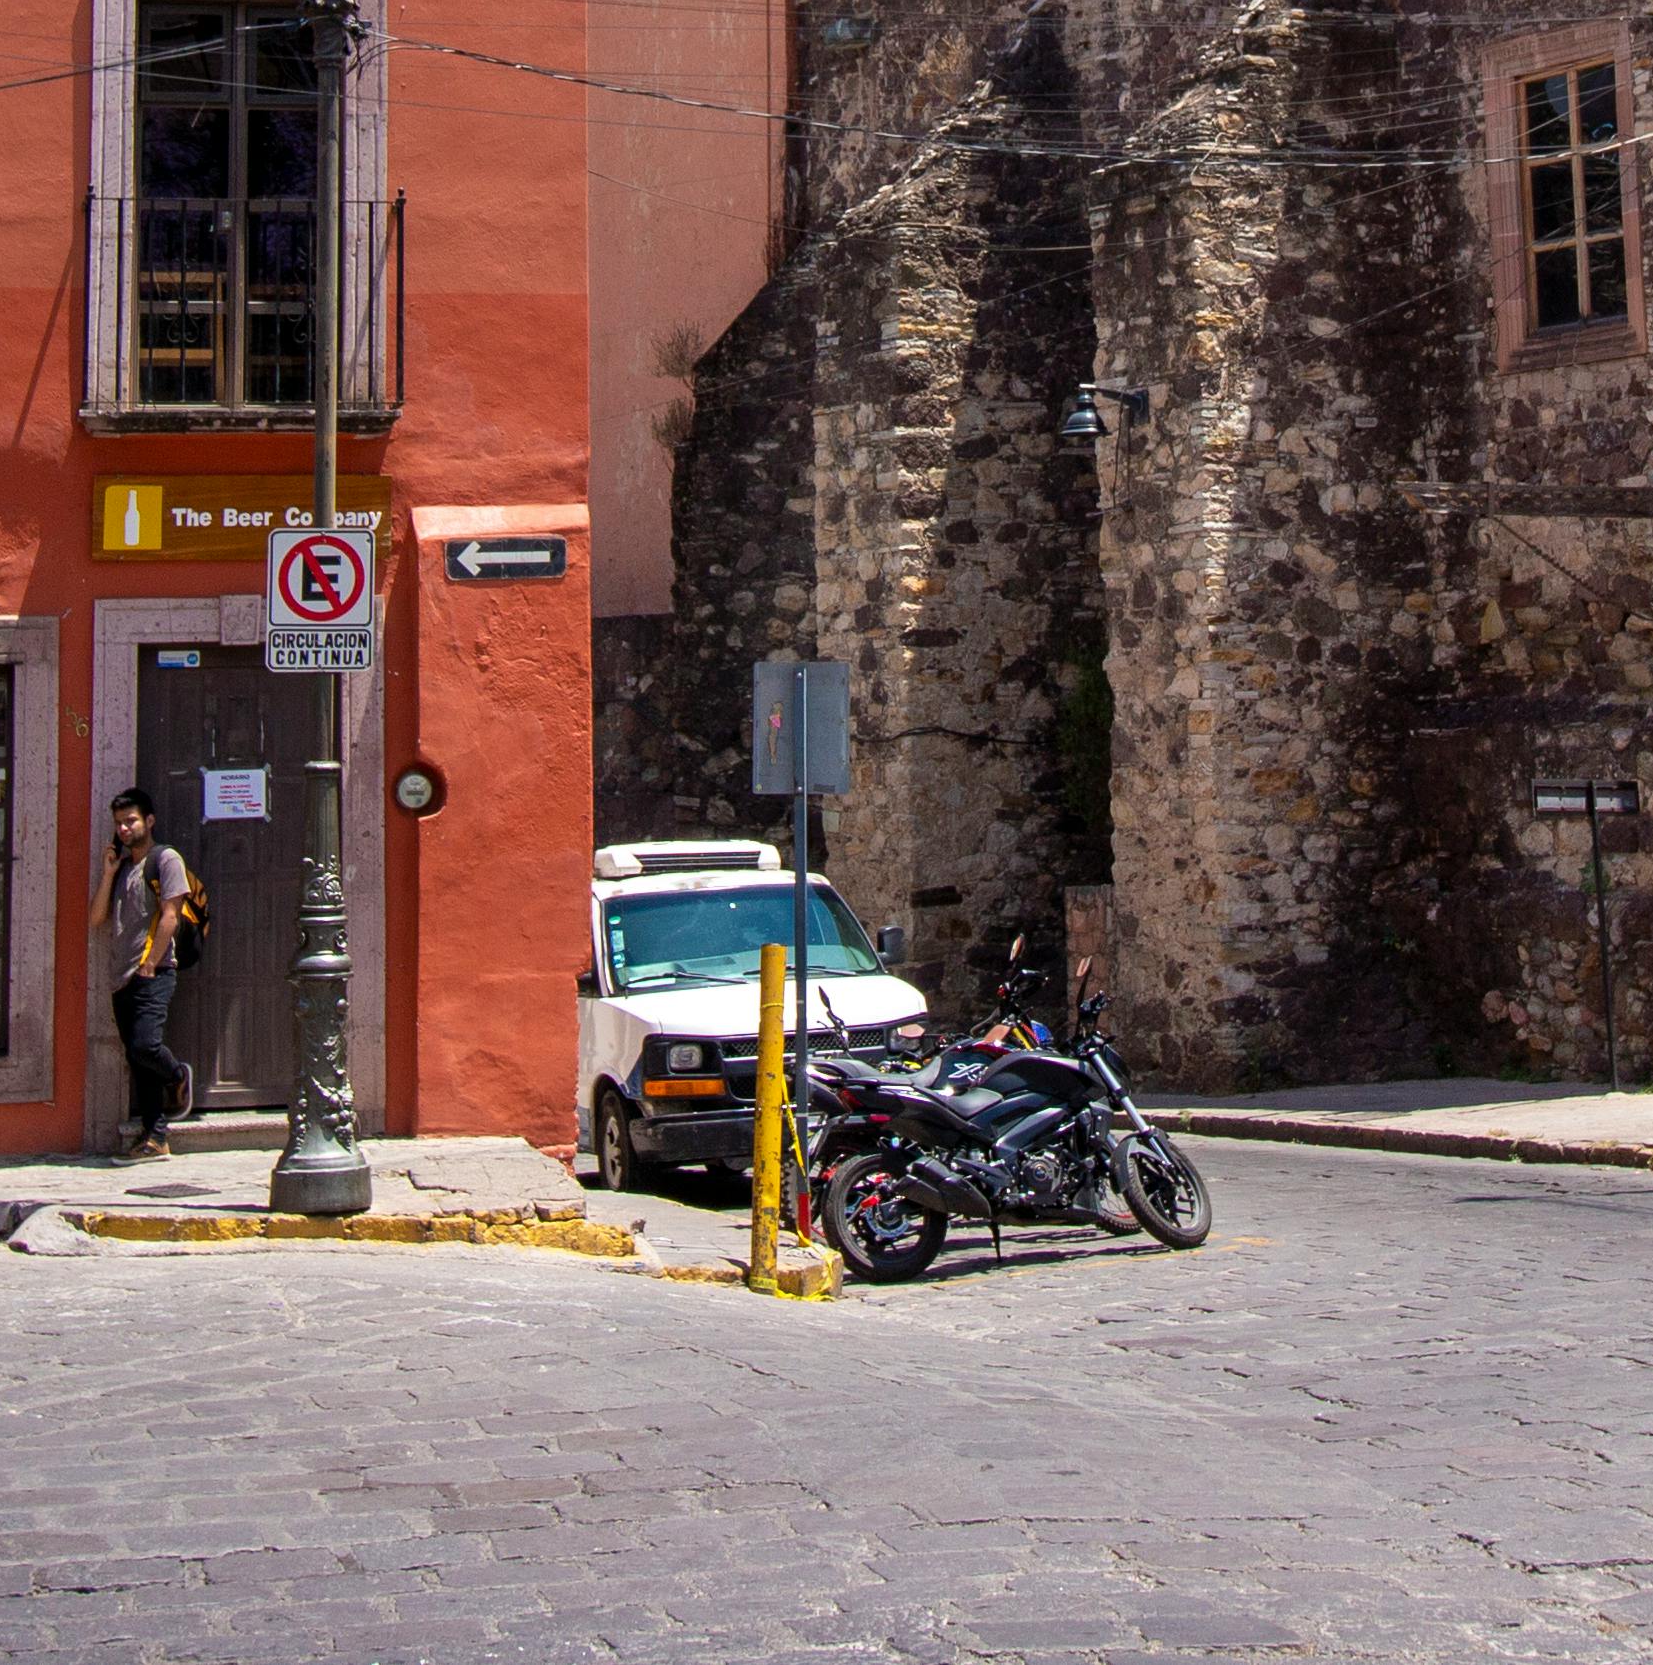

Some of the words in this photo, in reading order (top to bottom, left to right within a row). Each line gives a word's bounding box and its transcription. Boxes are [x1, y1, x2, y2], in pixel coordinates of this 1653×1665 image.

[172, 507, 212, 527] The
[222, 507, 273, 527] Beer
[285, 507, 382, 531] Copany
[272, 633, 368, 649] CIRCULACION
[275, 650, 365, 665] CONTINUA
